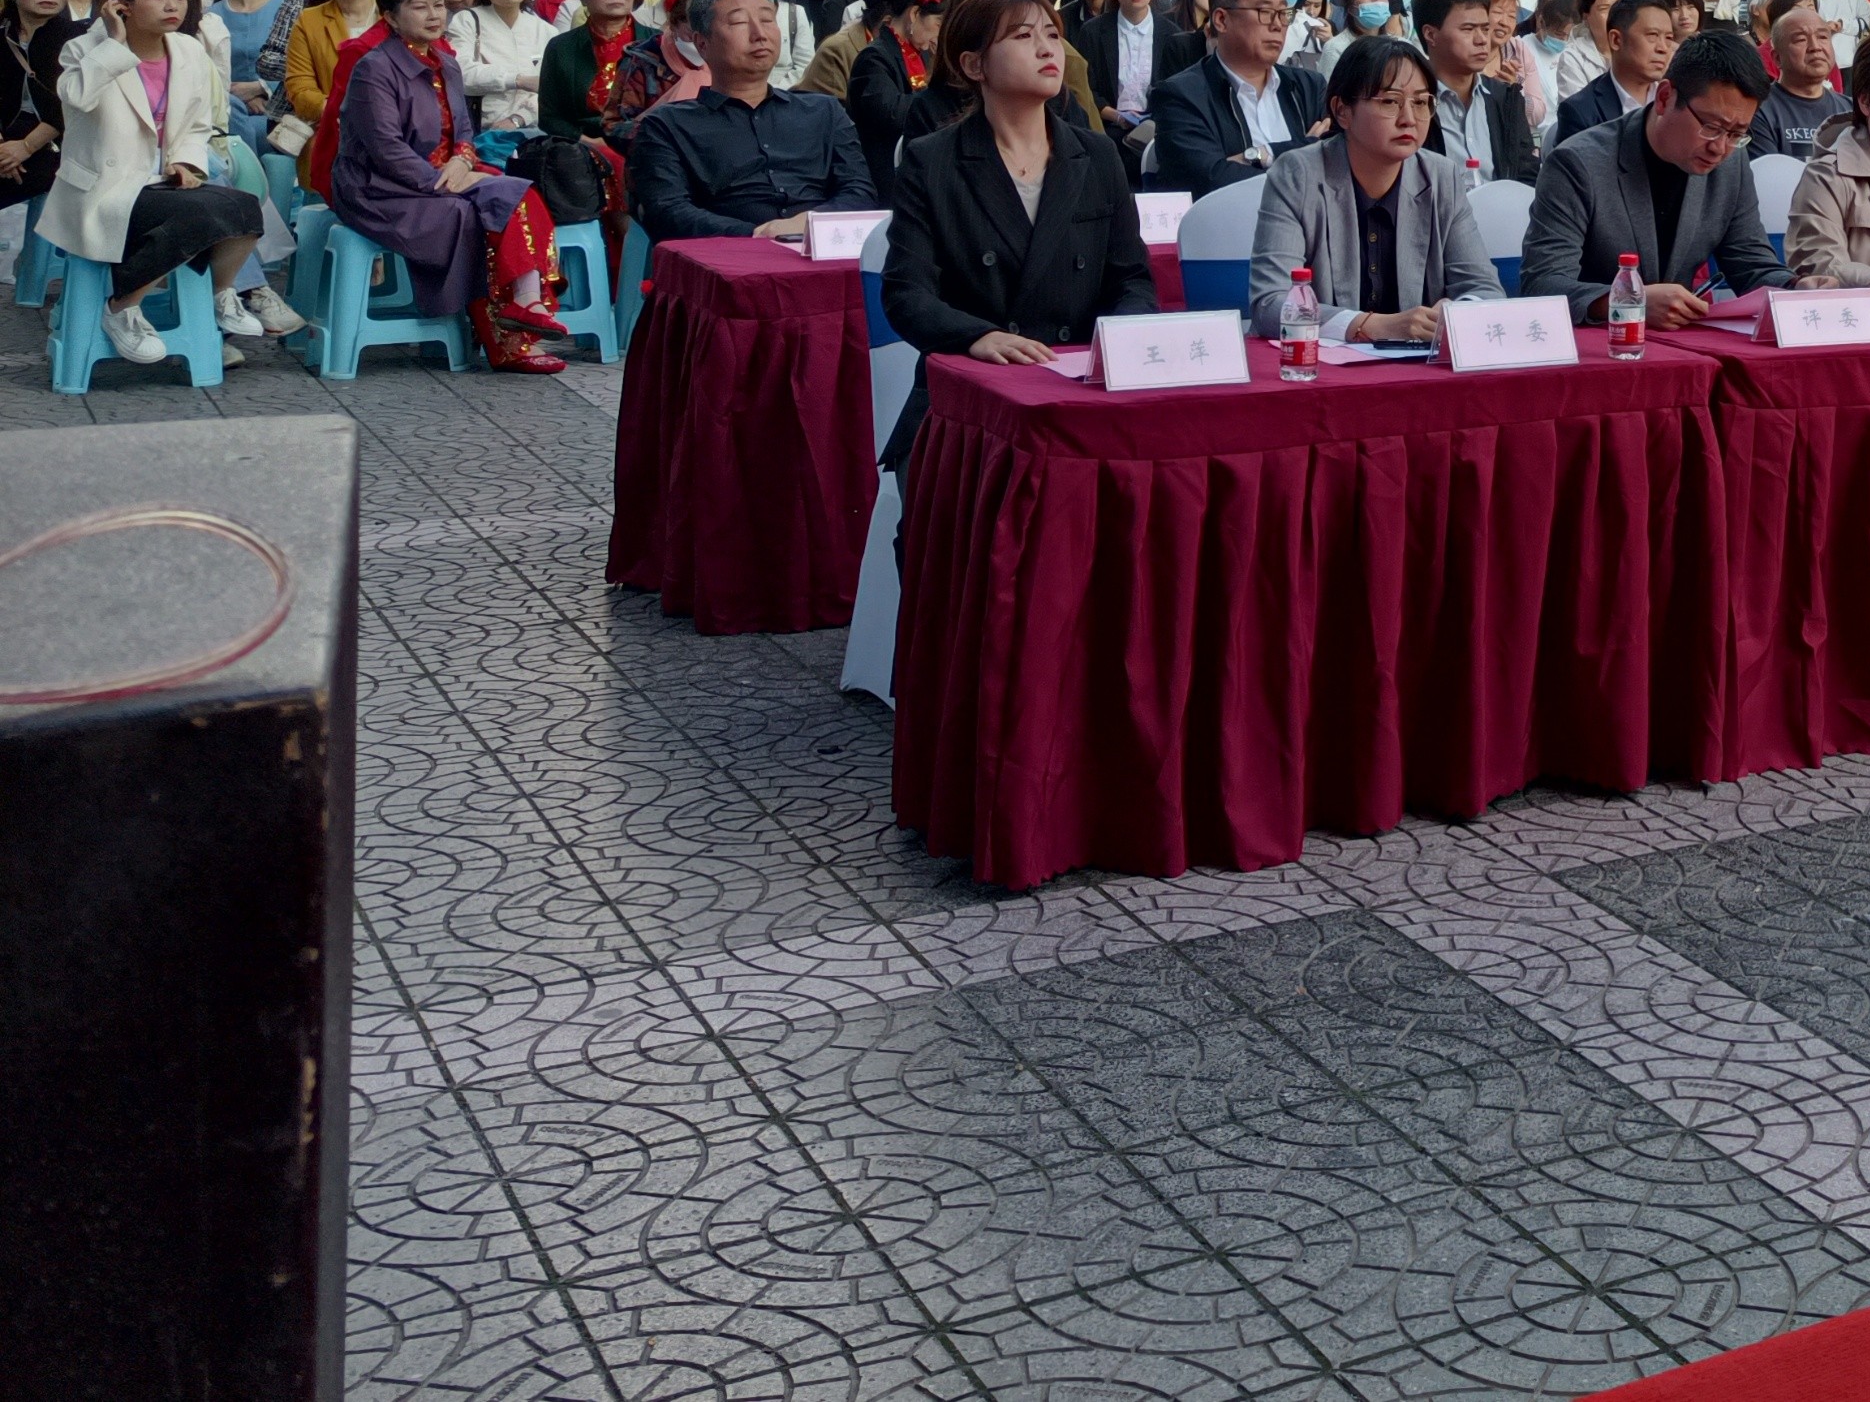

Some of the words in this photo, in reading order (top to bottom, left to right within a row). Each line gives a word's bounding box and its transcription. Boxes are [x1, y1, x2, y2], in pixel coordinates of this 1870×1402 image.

[1485, 319, 1548, 347] 评委
[1802, 307, 1859, 331] 评委
[1143, 338, 1210, 366] 王萍
